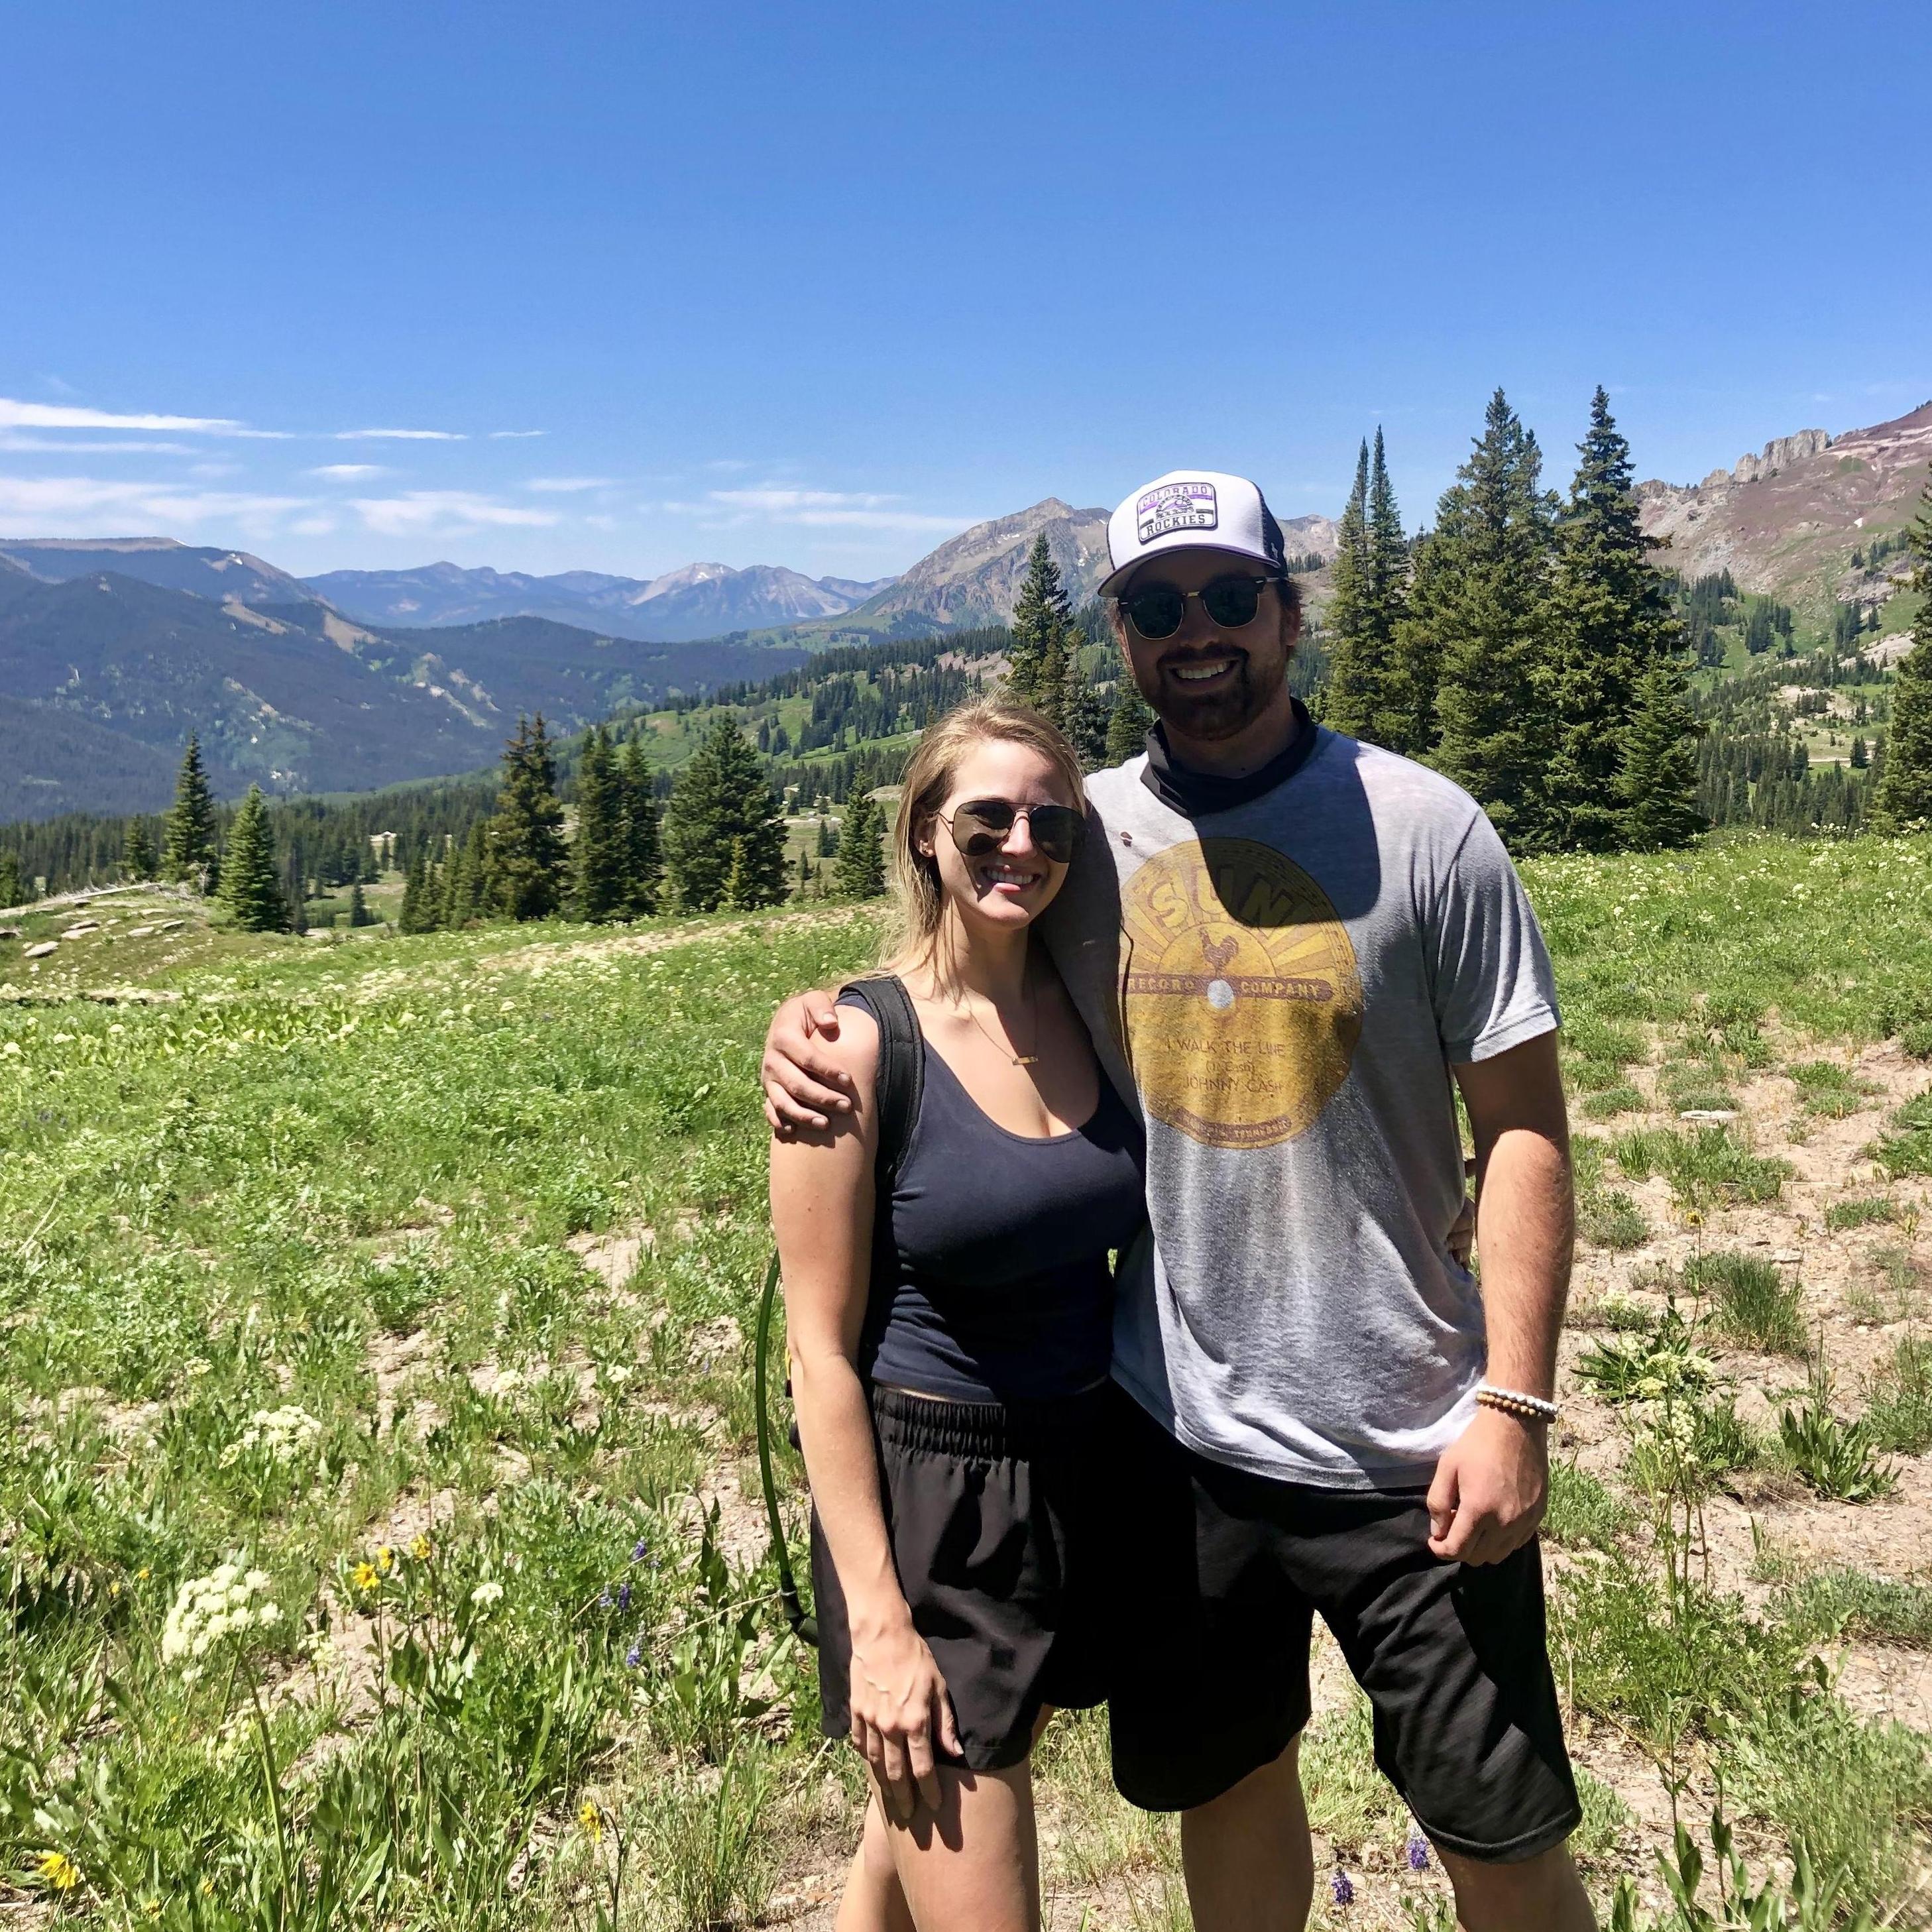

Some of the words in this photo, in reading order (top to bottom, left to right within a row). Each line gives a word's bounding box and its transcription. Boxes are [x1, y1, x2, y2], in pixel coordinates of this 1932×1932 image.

[1143, 486, 1208, 506] COLORADO
[1147, 514, 1205, 536] ROCKIES
[1147, 864, 1294, 940] SUN
[1241, 981, 1320, 997] COMPANY
[1176, 1039, 1218, 1053] WALK
[1223, 1041, 1252, 1054] THE
[1257, 1043, 1286, 1056] LINE
[1182, 1076, 1240, 1091] JOHNNY
[1245, 1080, 1282, 1093] CASH
